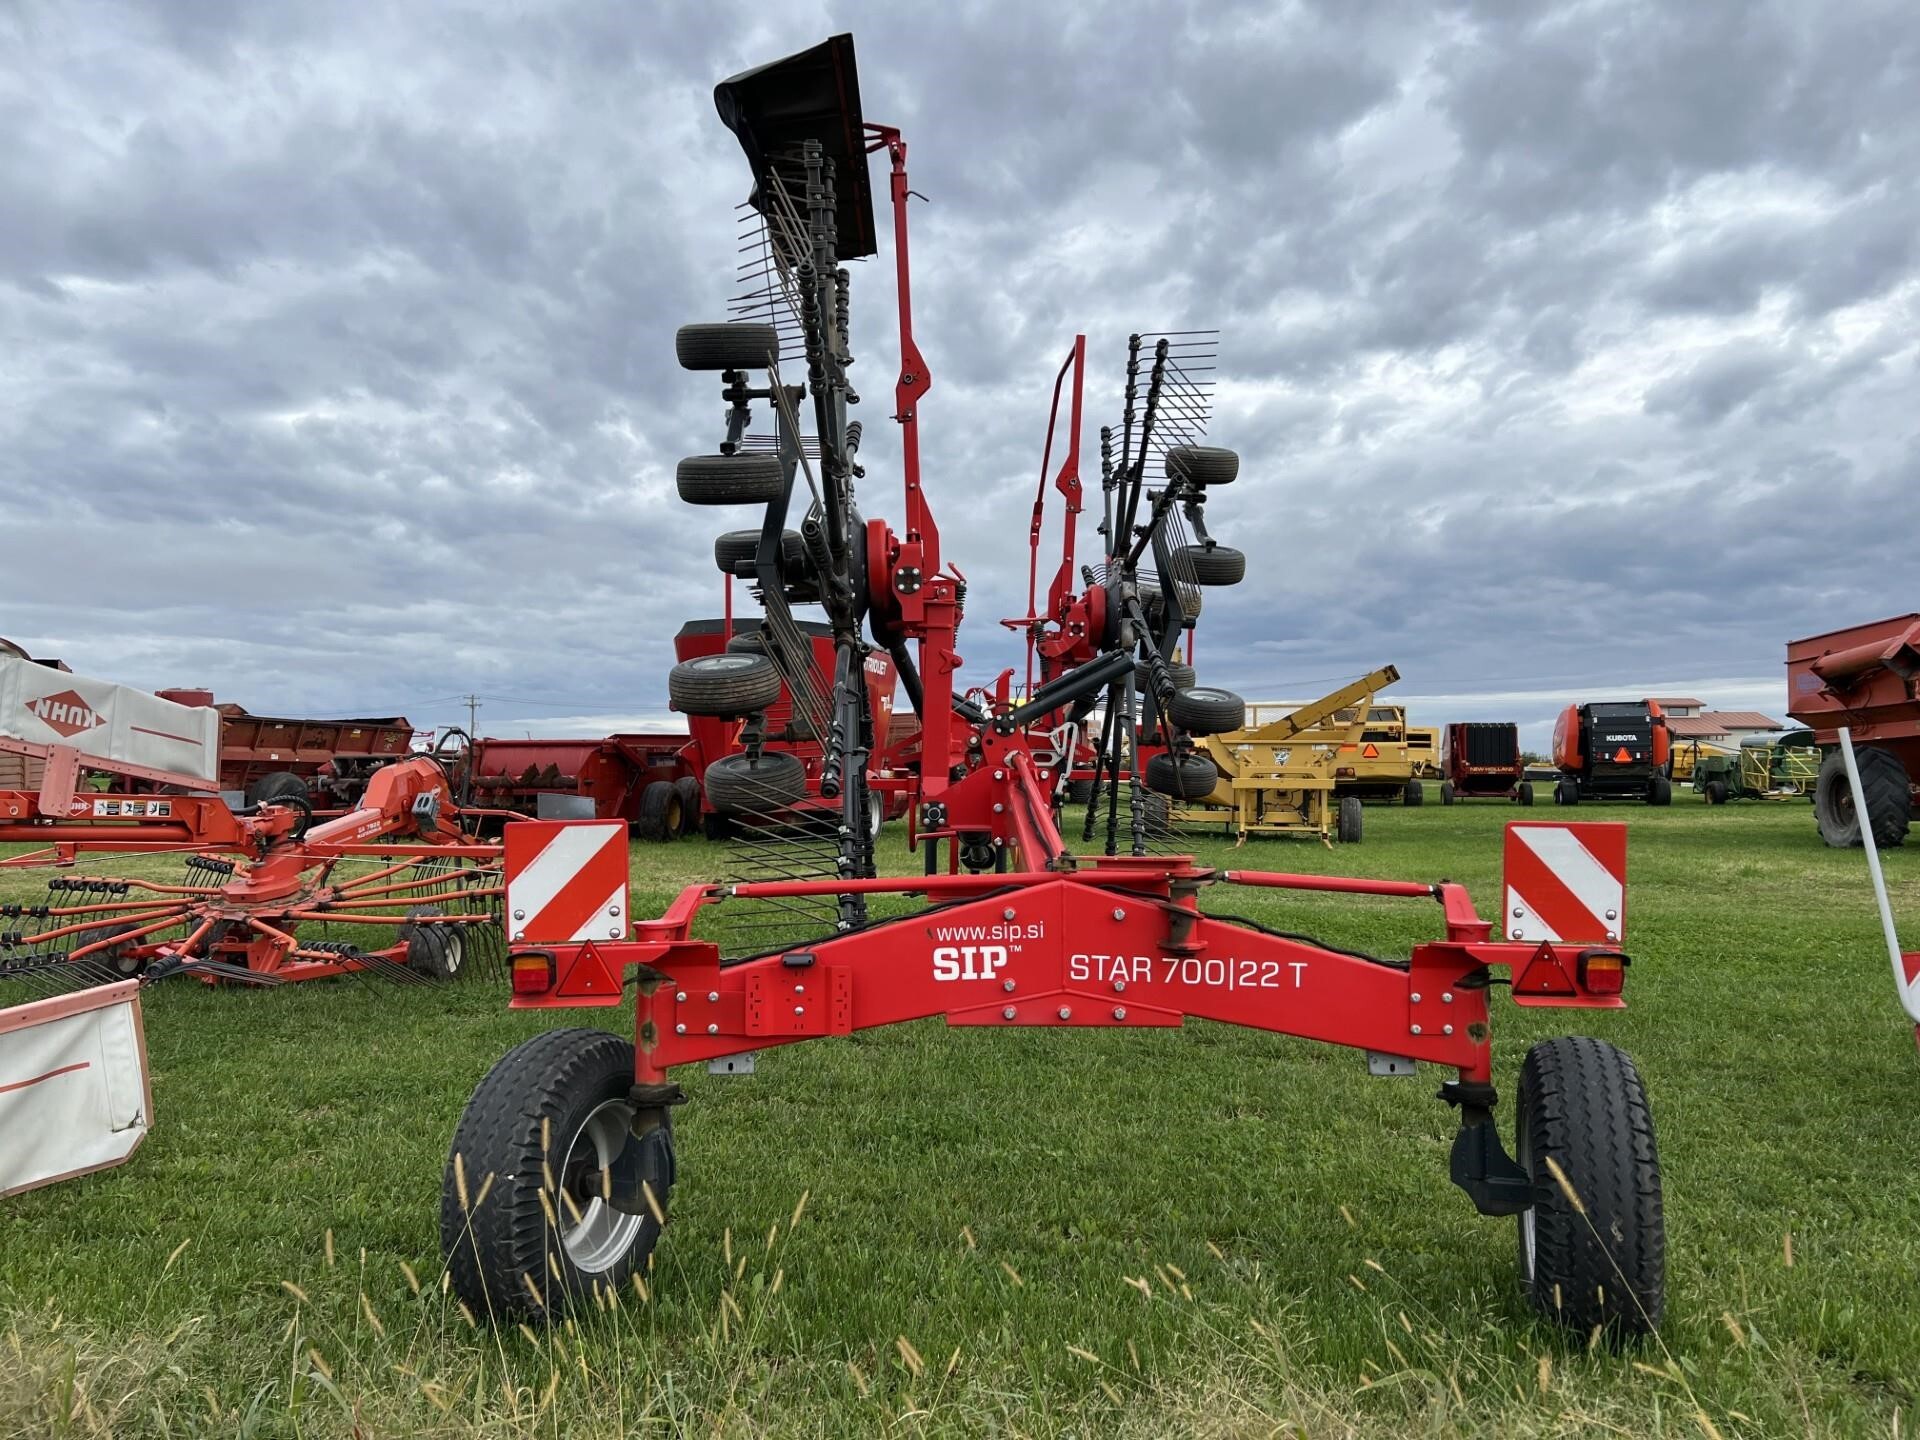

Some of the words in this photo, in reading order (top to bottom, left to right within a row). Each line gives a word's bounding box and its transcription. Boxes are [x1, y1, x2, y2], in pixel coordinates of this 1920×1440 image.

[33, 697, 98, 729] KUHN
[1606, 734, 1637, 742] KUBOTA
[936, 920, 1045, 942] www.sip.si
[1069, 954, 1152, 983] STAR
[1288, 962, 1309, 988] T
